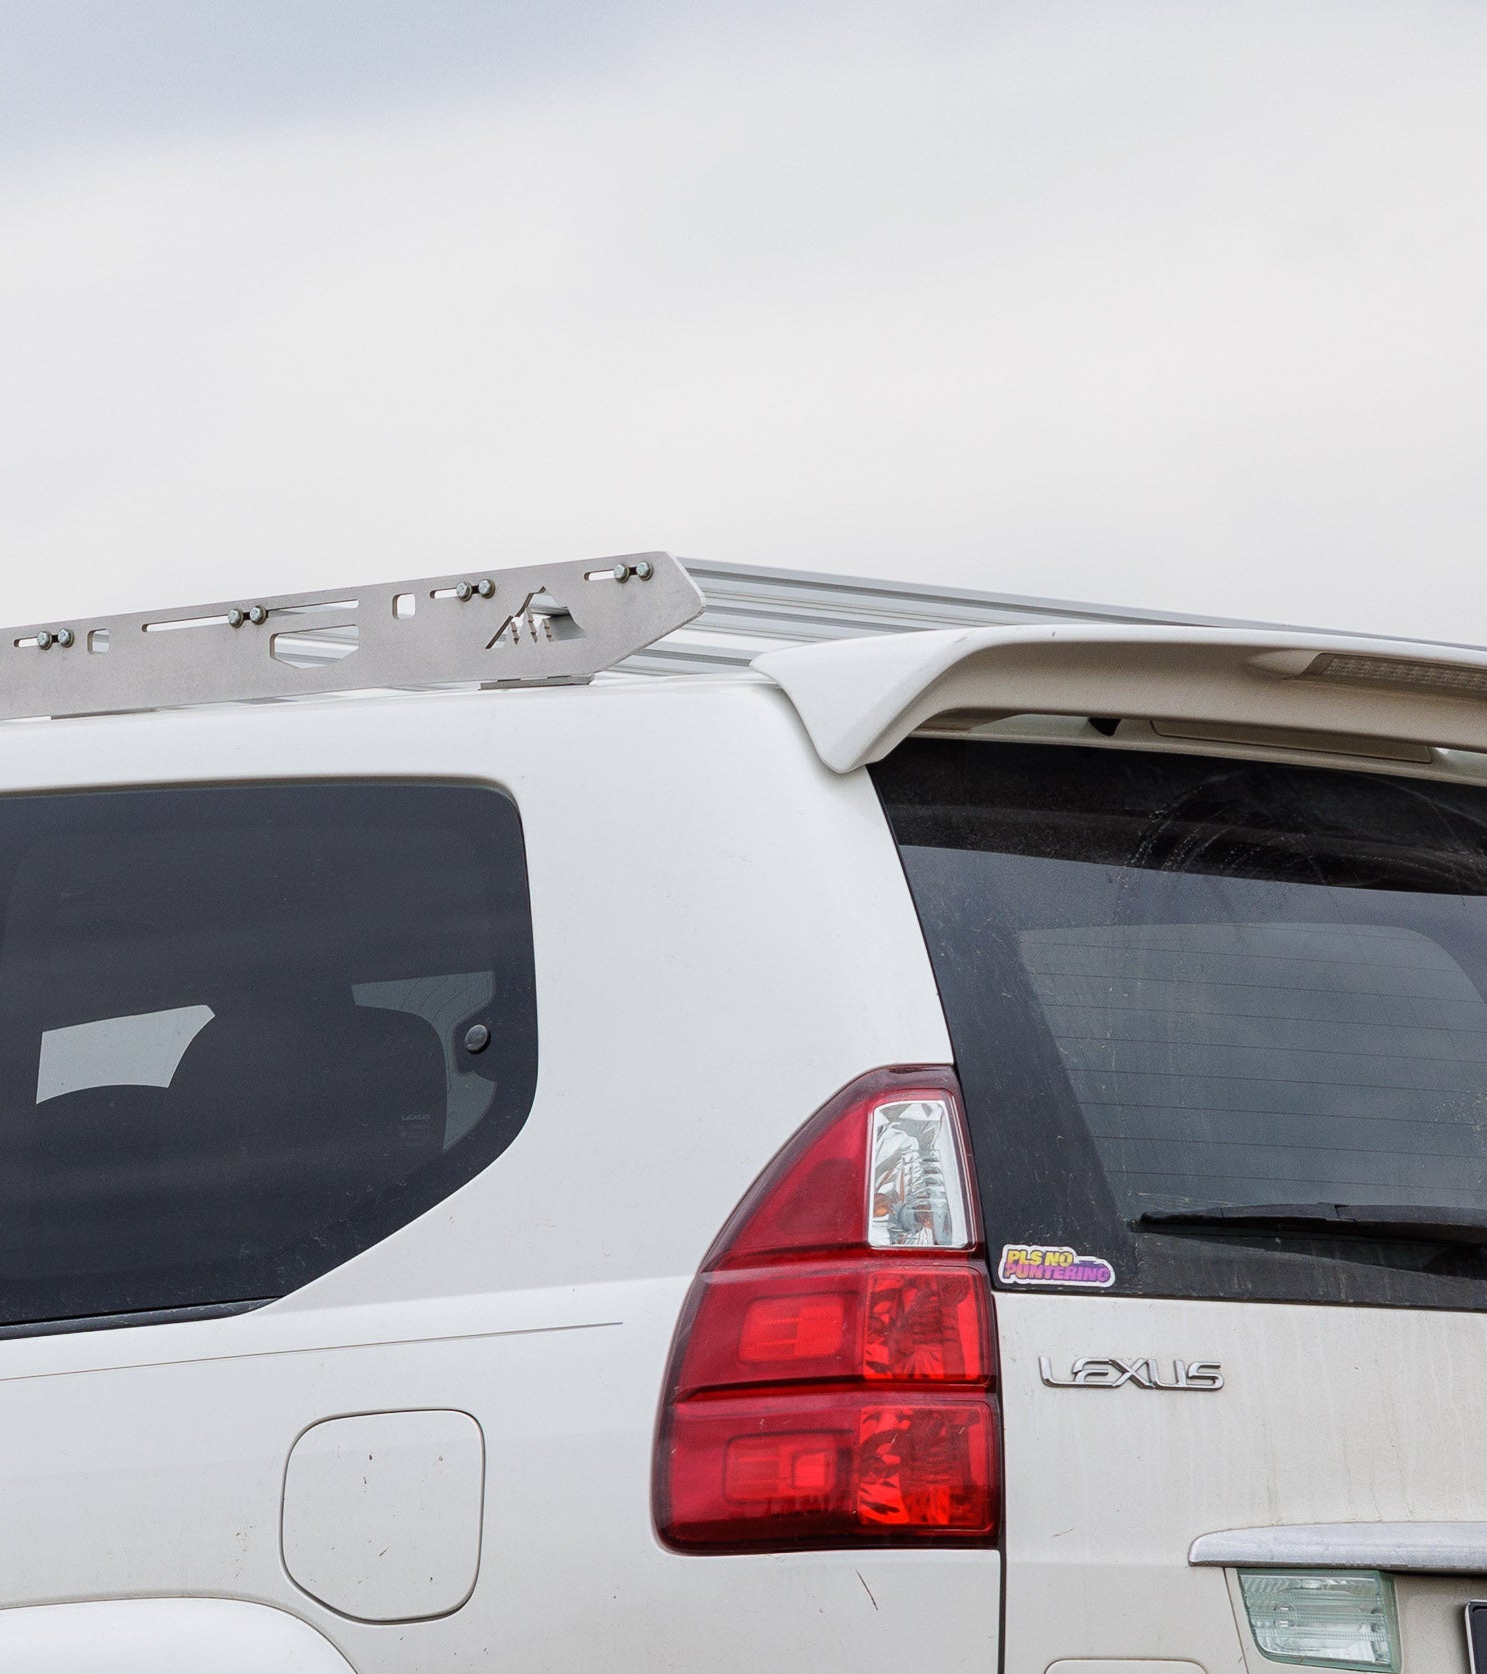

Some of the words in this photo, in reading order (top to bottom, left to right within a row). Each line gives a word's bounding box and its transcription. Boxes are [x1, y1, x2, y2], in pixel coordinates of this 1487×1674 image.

[1006, 1249, 1043, 1266] PLS
[1045, 1250, 1074, 1267] NO
[1004, 1264, 1111, 1282] PUNTERING
[1039, 1355, 1225, 1391] LEXUS
